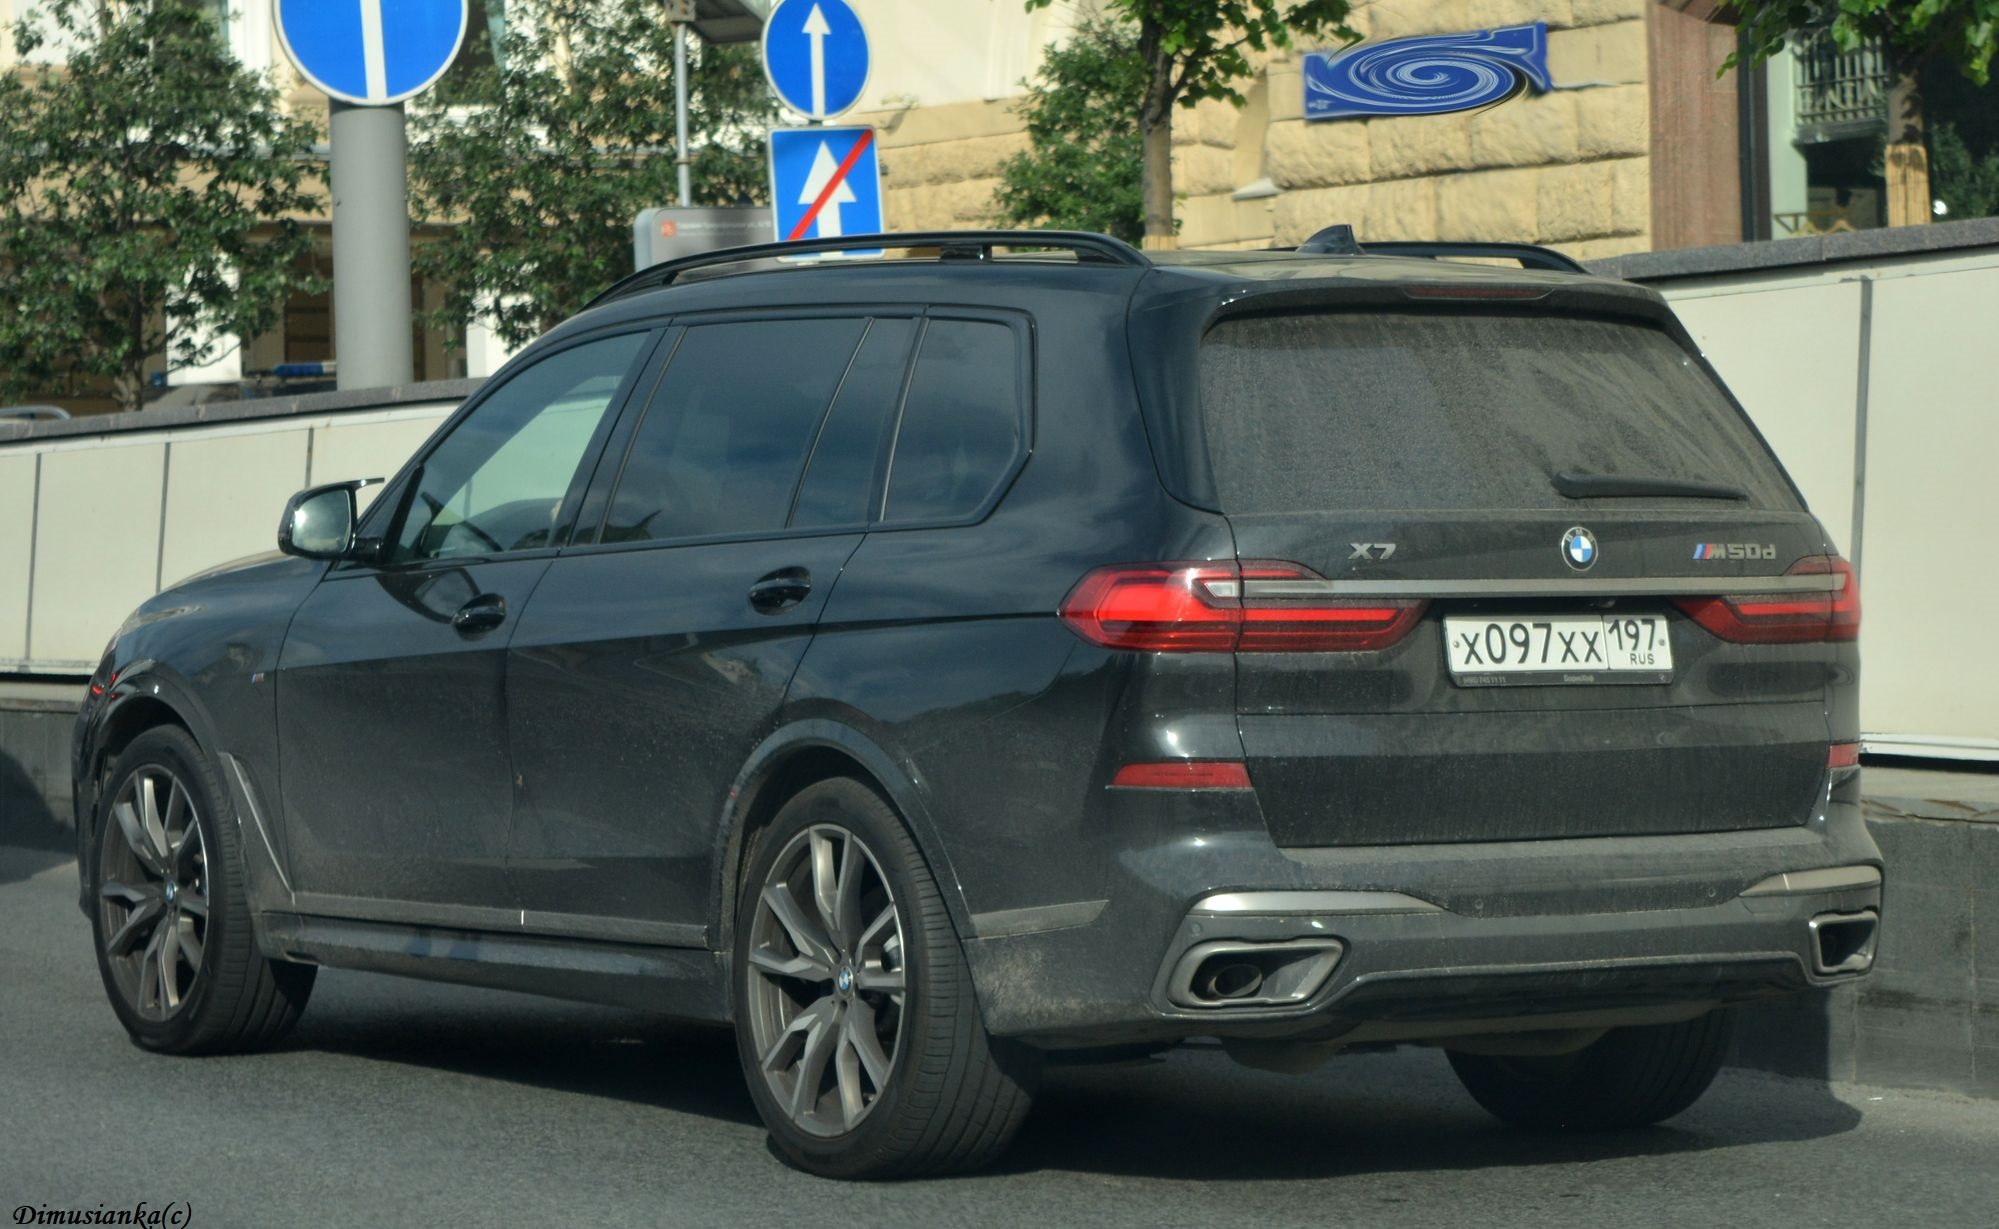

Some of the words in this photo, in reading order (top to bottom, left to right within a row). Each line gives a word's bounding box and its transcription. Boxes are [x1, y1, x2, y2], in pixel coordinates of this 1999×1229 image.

[1348, 543, 1397, 560] X7
[1709, 543, 1776, 560] M50d
[1608, 618, 1656, 651] 197
[1629, 653, 1655, 665] RUS
